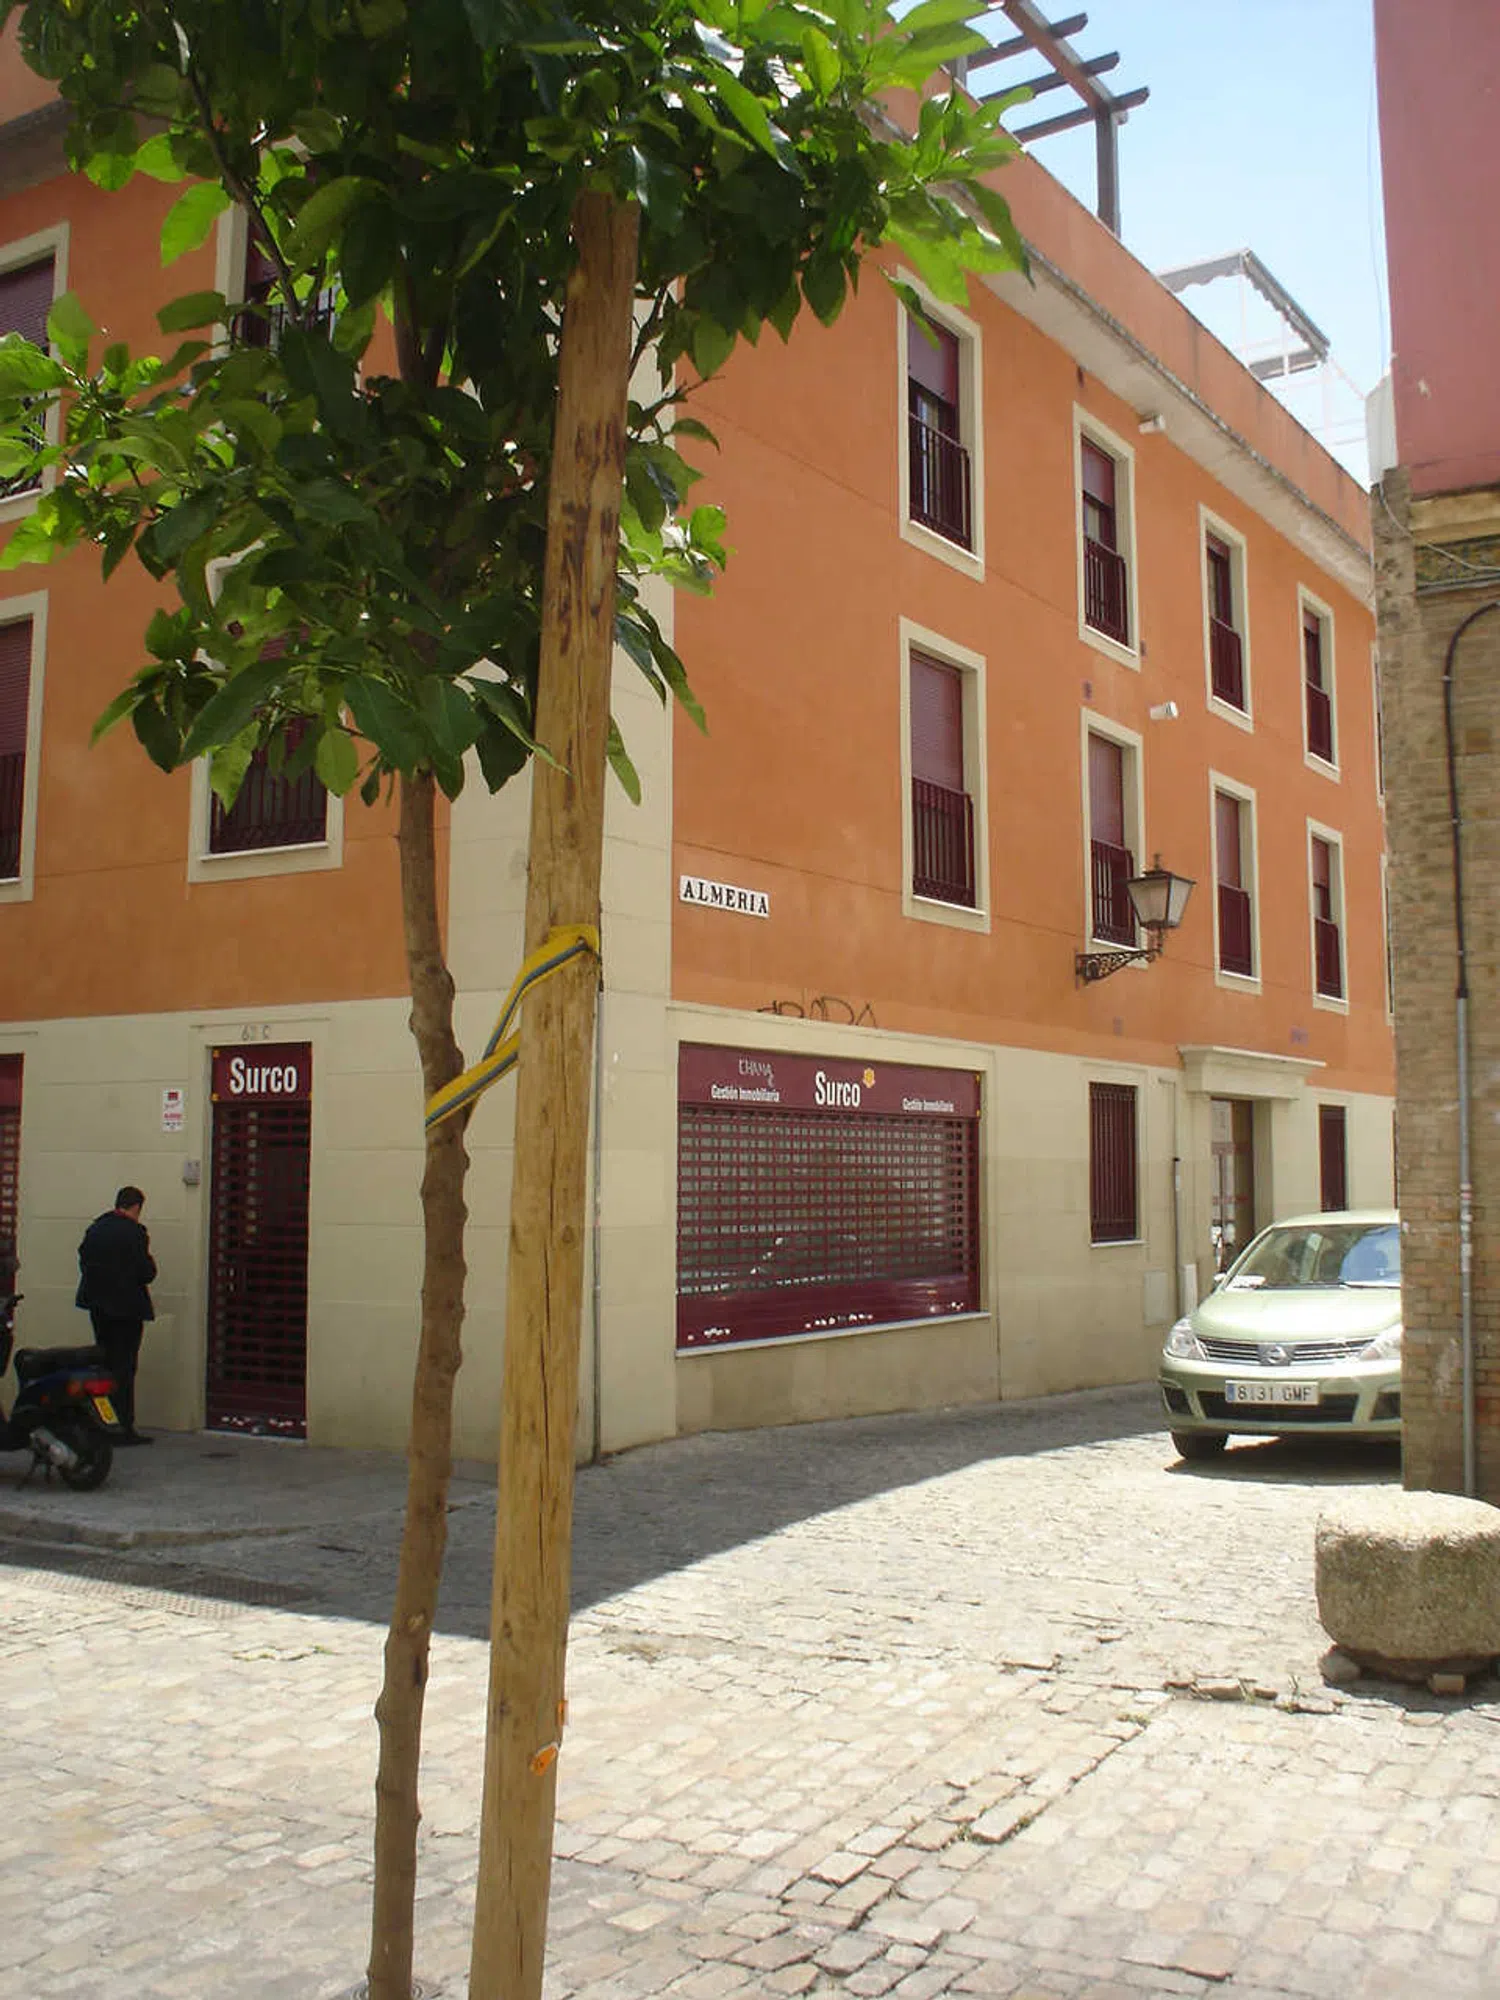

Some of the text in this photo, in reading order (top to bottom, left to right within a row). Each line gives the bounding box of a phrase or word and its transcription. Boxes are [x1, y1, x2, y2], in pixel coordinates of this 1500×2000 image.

[683, 880, 769, 914] ALMERIA
[230, 1057, 297, 1094] Surco
[815, 1071, 860, 1107] Surco
